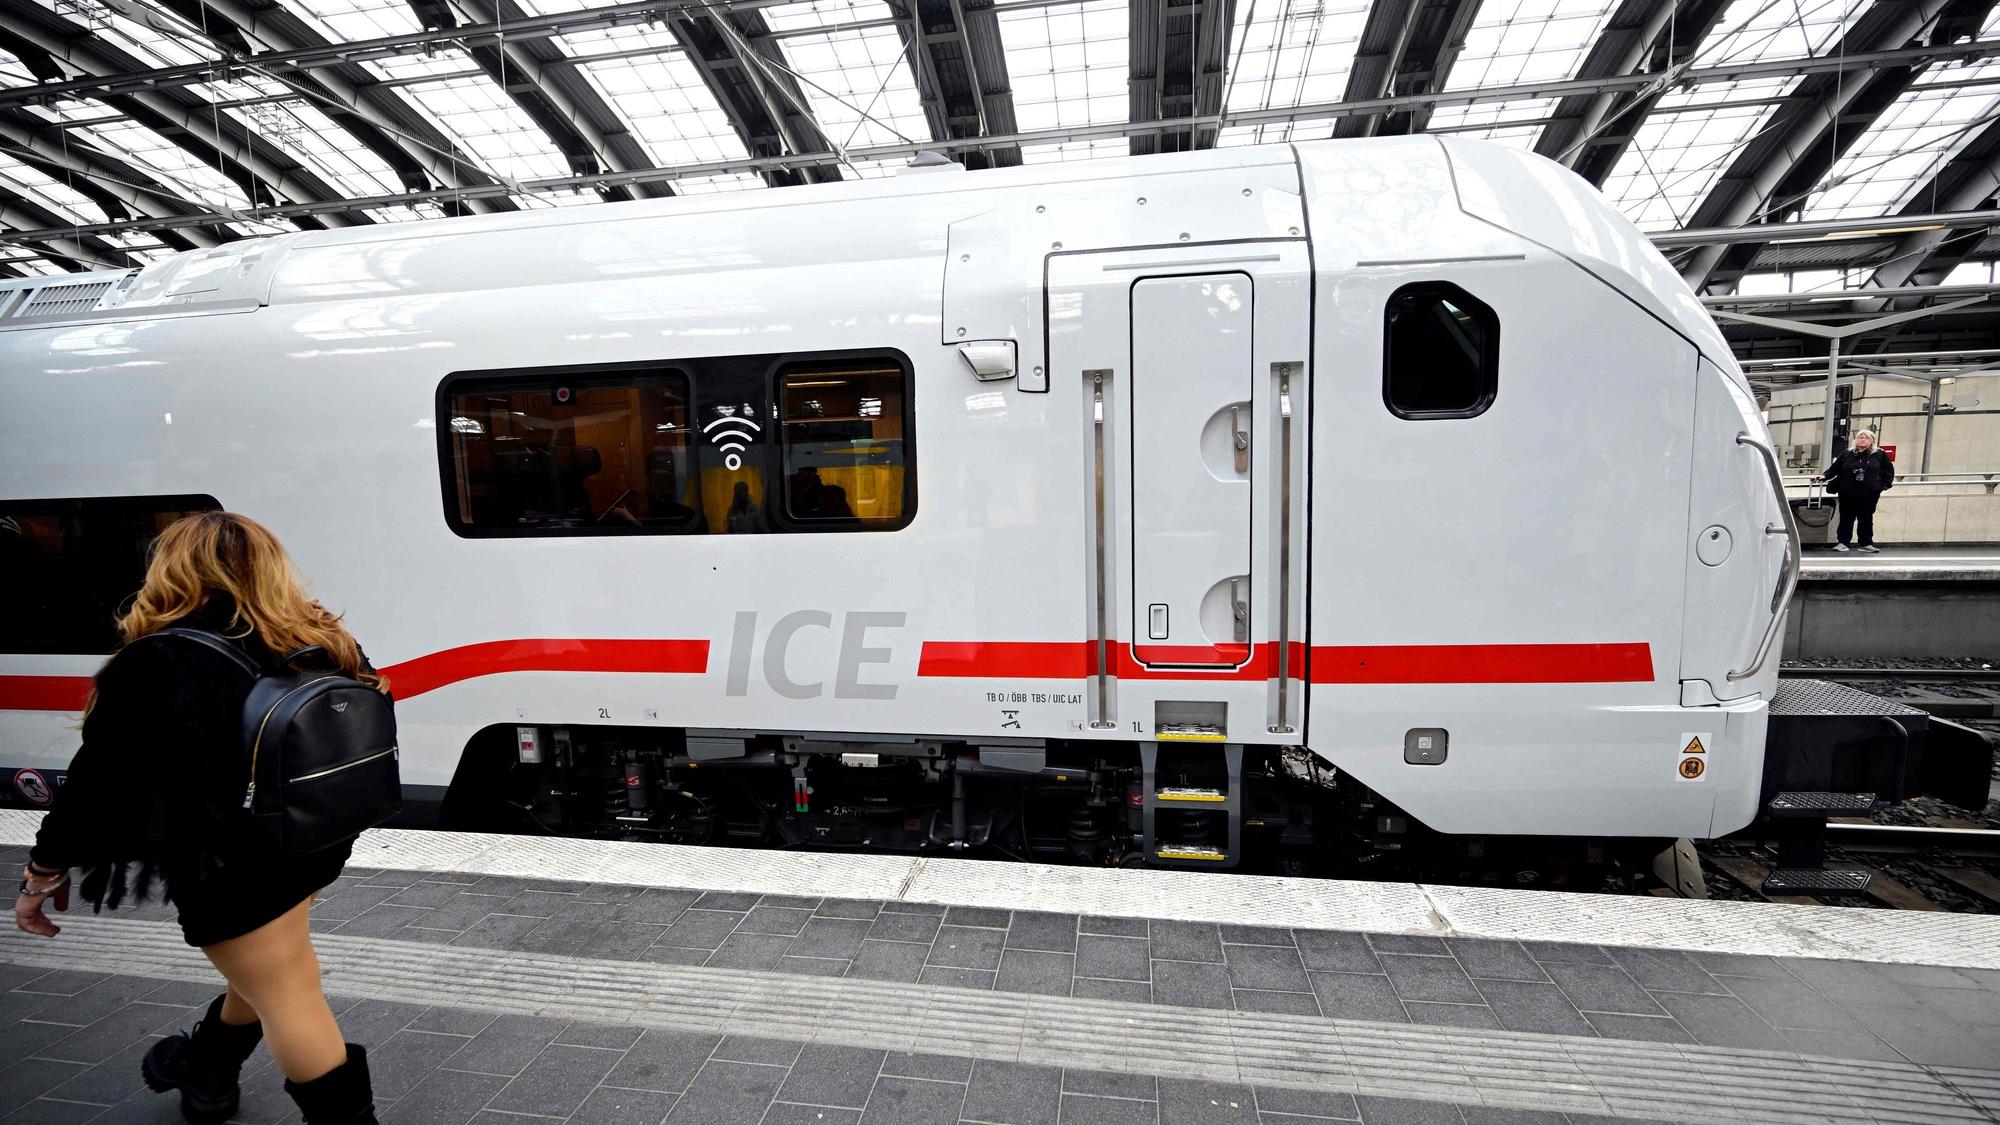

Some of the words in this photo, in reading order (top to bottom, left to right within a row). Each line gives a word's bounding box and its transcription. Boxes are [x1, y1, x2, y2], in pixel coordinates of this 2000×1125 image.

[725, 609, 907, 701] ICE
[985, 692, 997, 702] TB
[1011, 691, 1027, 703] ÖBB
[1031, 693, 1046, 704] TBS
[1052, 694, 1066, 704] UIC
[1067, 694, 1083, 704] LAT
[598, 707, 611, 719] 2L
[1131, 721, 1144, 733] 1L
